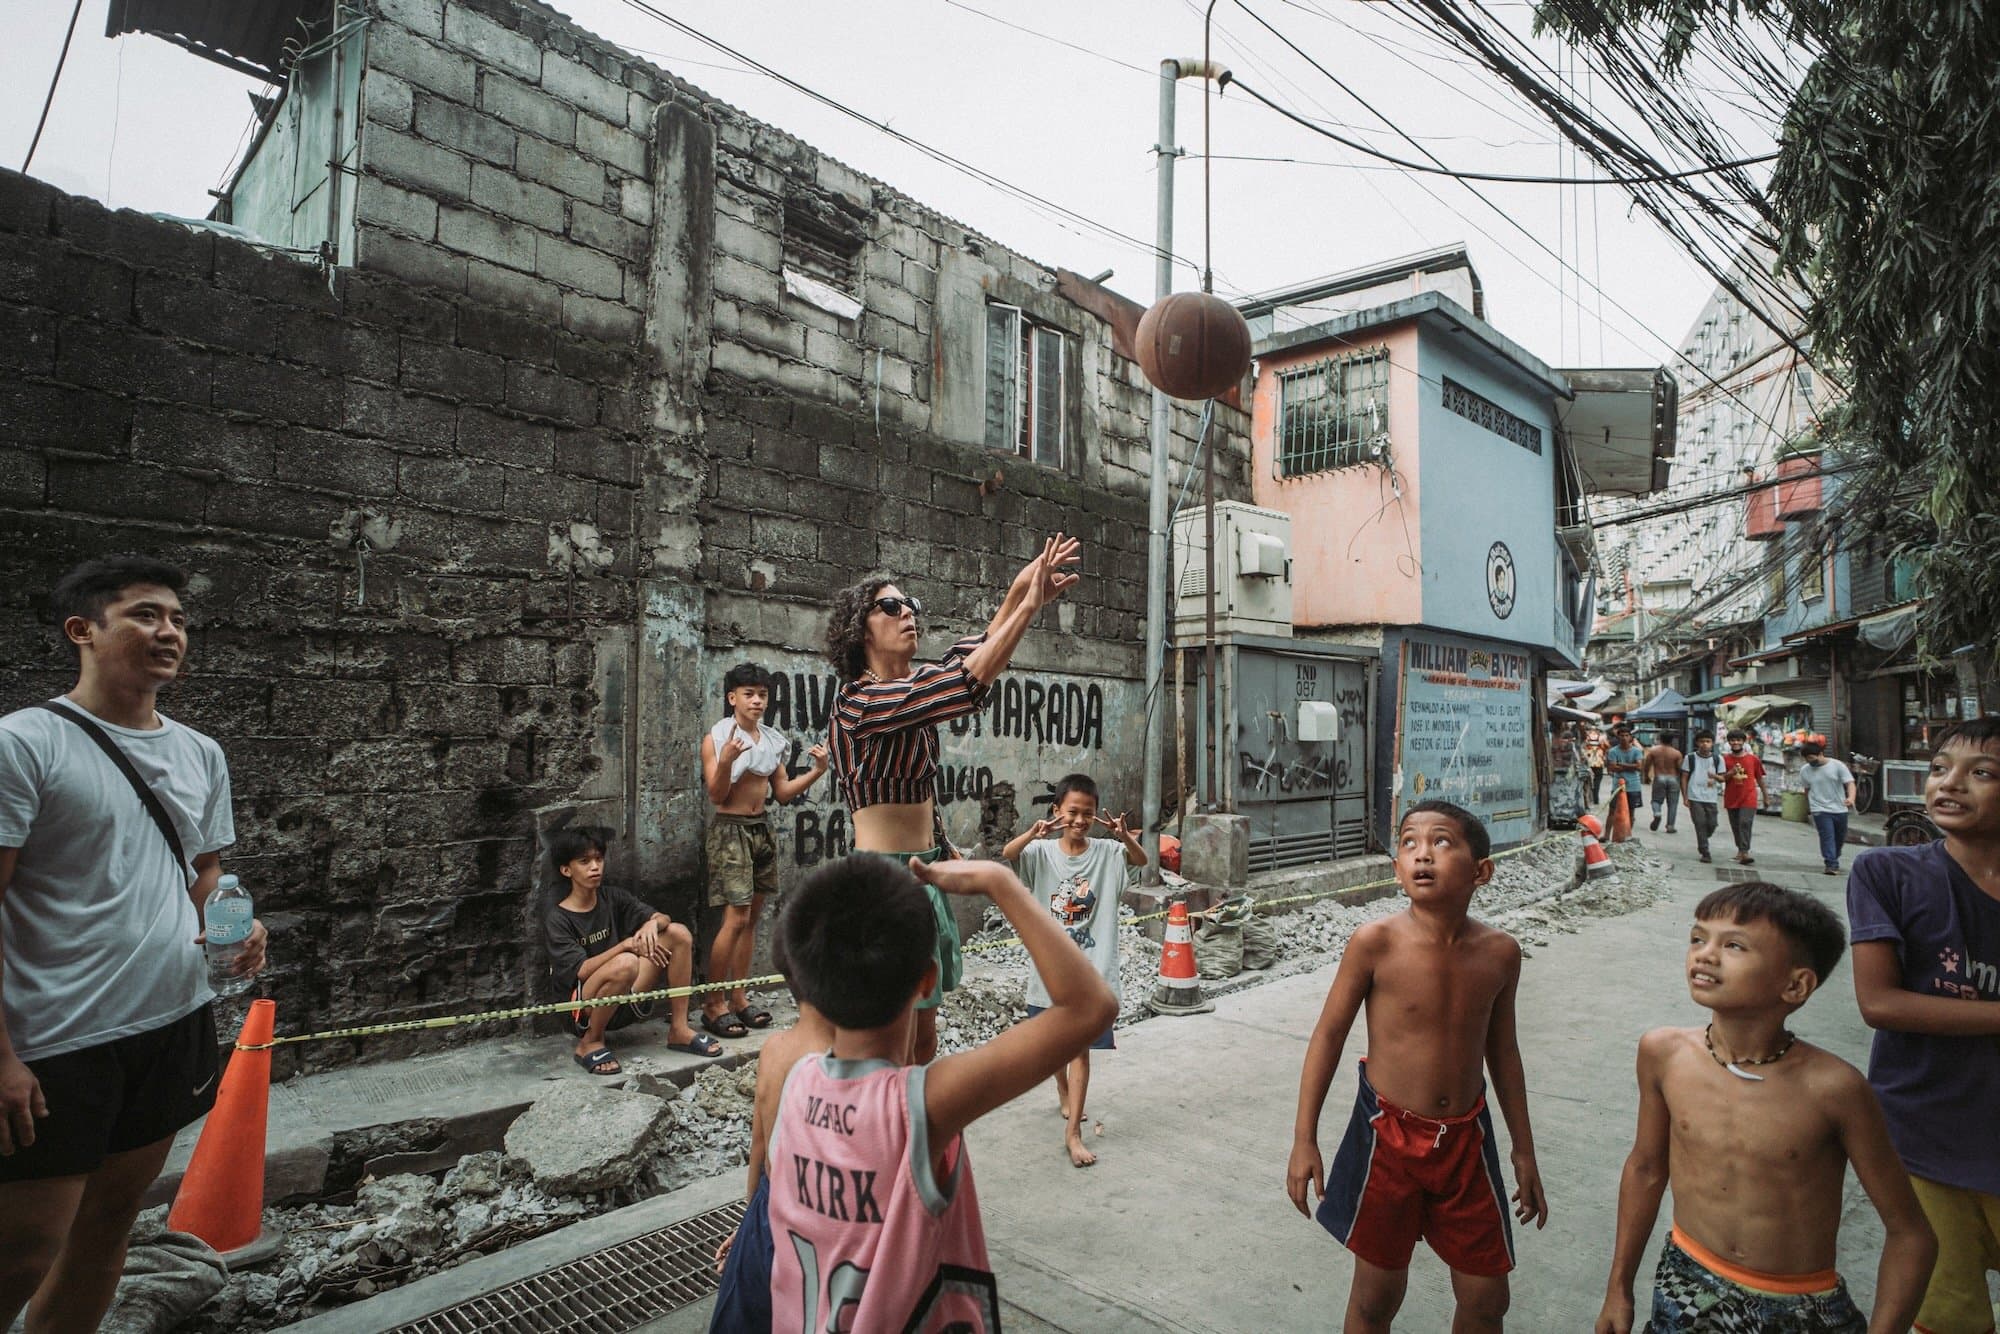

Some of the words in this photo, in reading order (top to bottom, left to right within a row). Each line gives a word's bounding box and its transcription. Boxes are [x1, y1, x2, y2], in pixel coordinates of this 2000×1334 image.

[1411, 642, 1467, 673] WILLIAM
[1296, 681, 1316, 697] 087
[793, 1154, 885, 1224] KIRK
